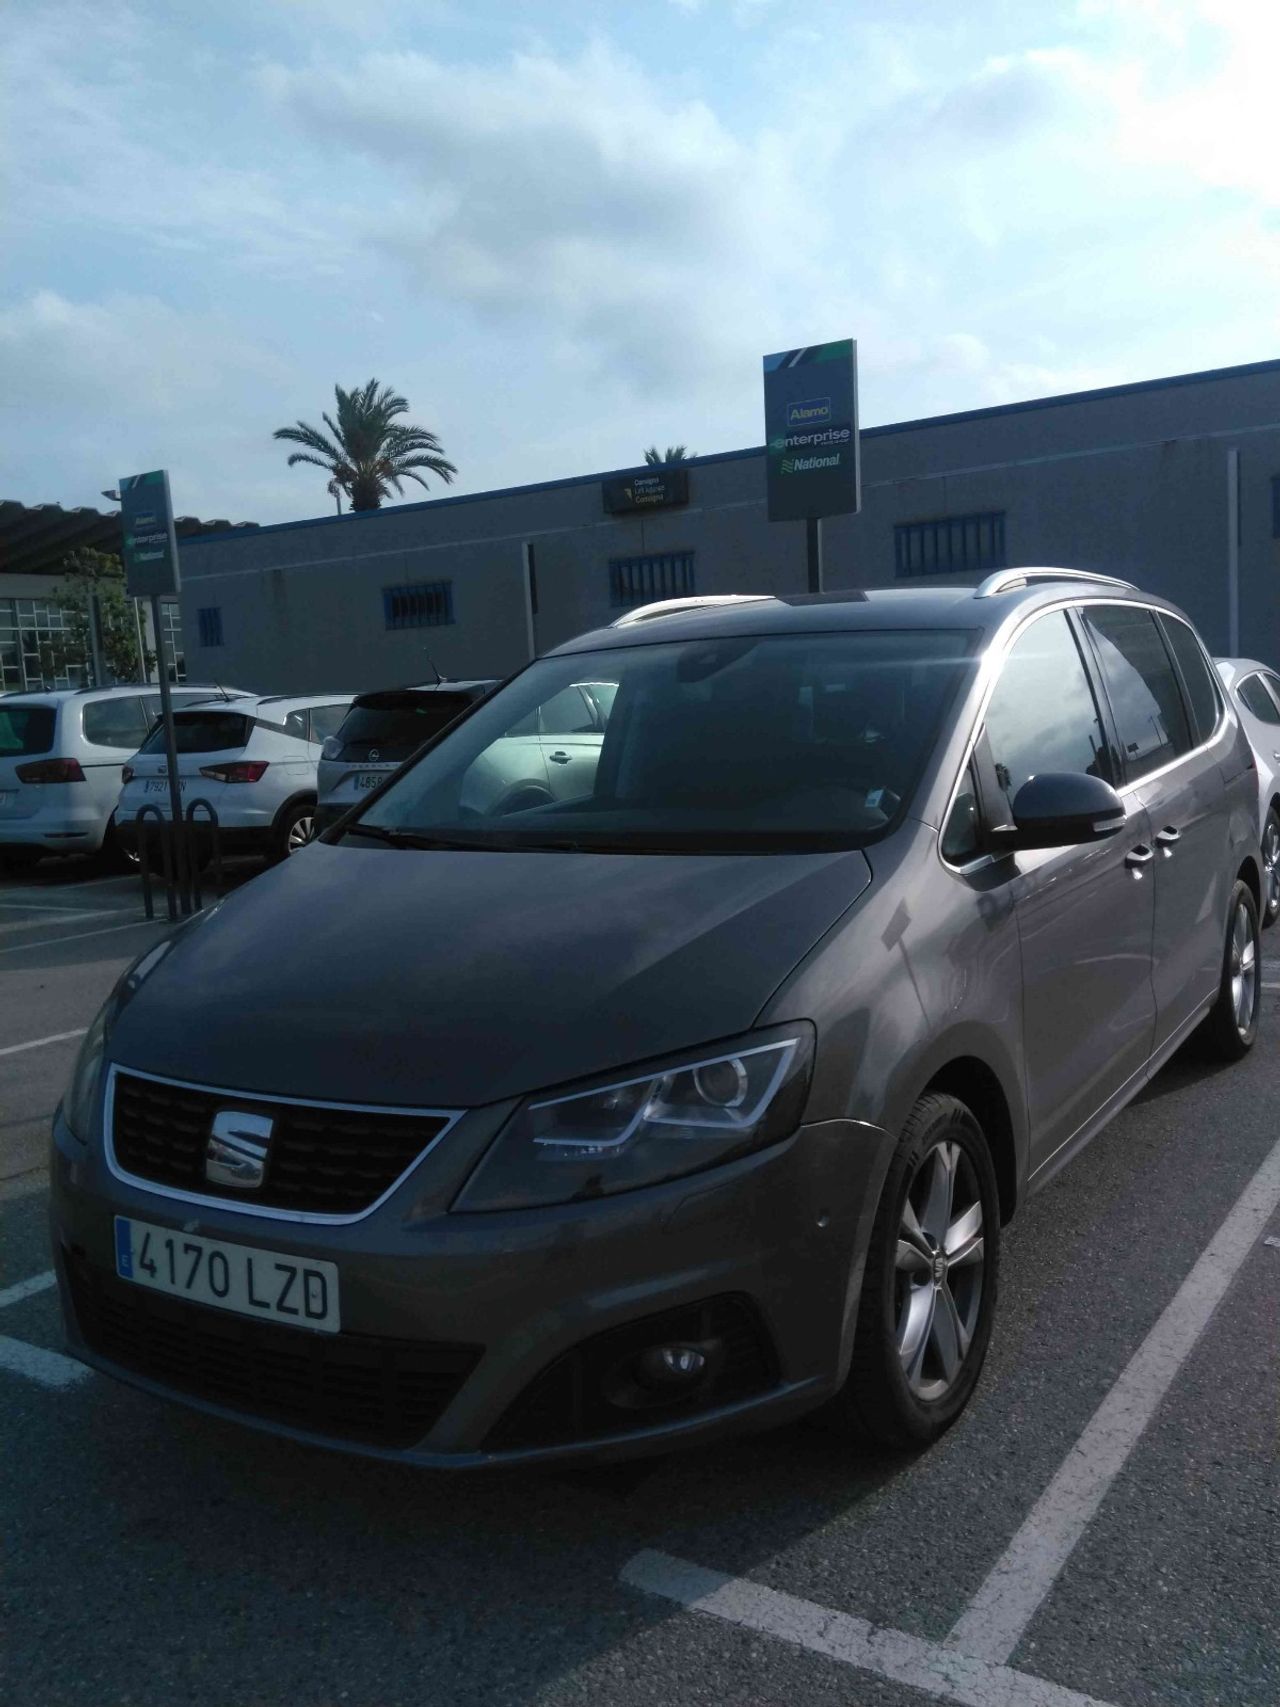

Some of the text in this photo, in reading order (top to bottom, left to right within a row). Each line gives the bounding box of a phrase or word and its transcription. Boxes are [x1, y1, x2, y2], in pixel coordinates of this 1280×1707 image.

[790, 406, 829, 420] Alamo
[771, 428, 850, 449] enterprise
[793, 453, 841, 471] National
[139, 1232, 230, 1298] 4170
[247, 1257, 329, 1320] LZD
